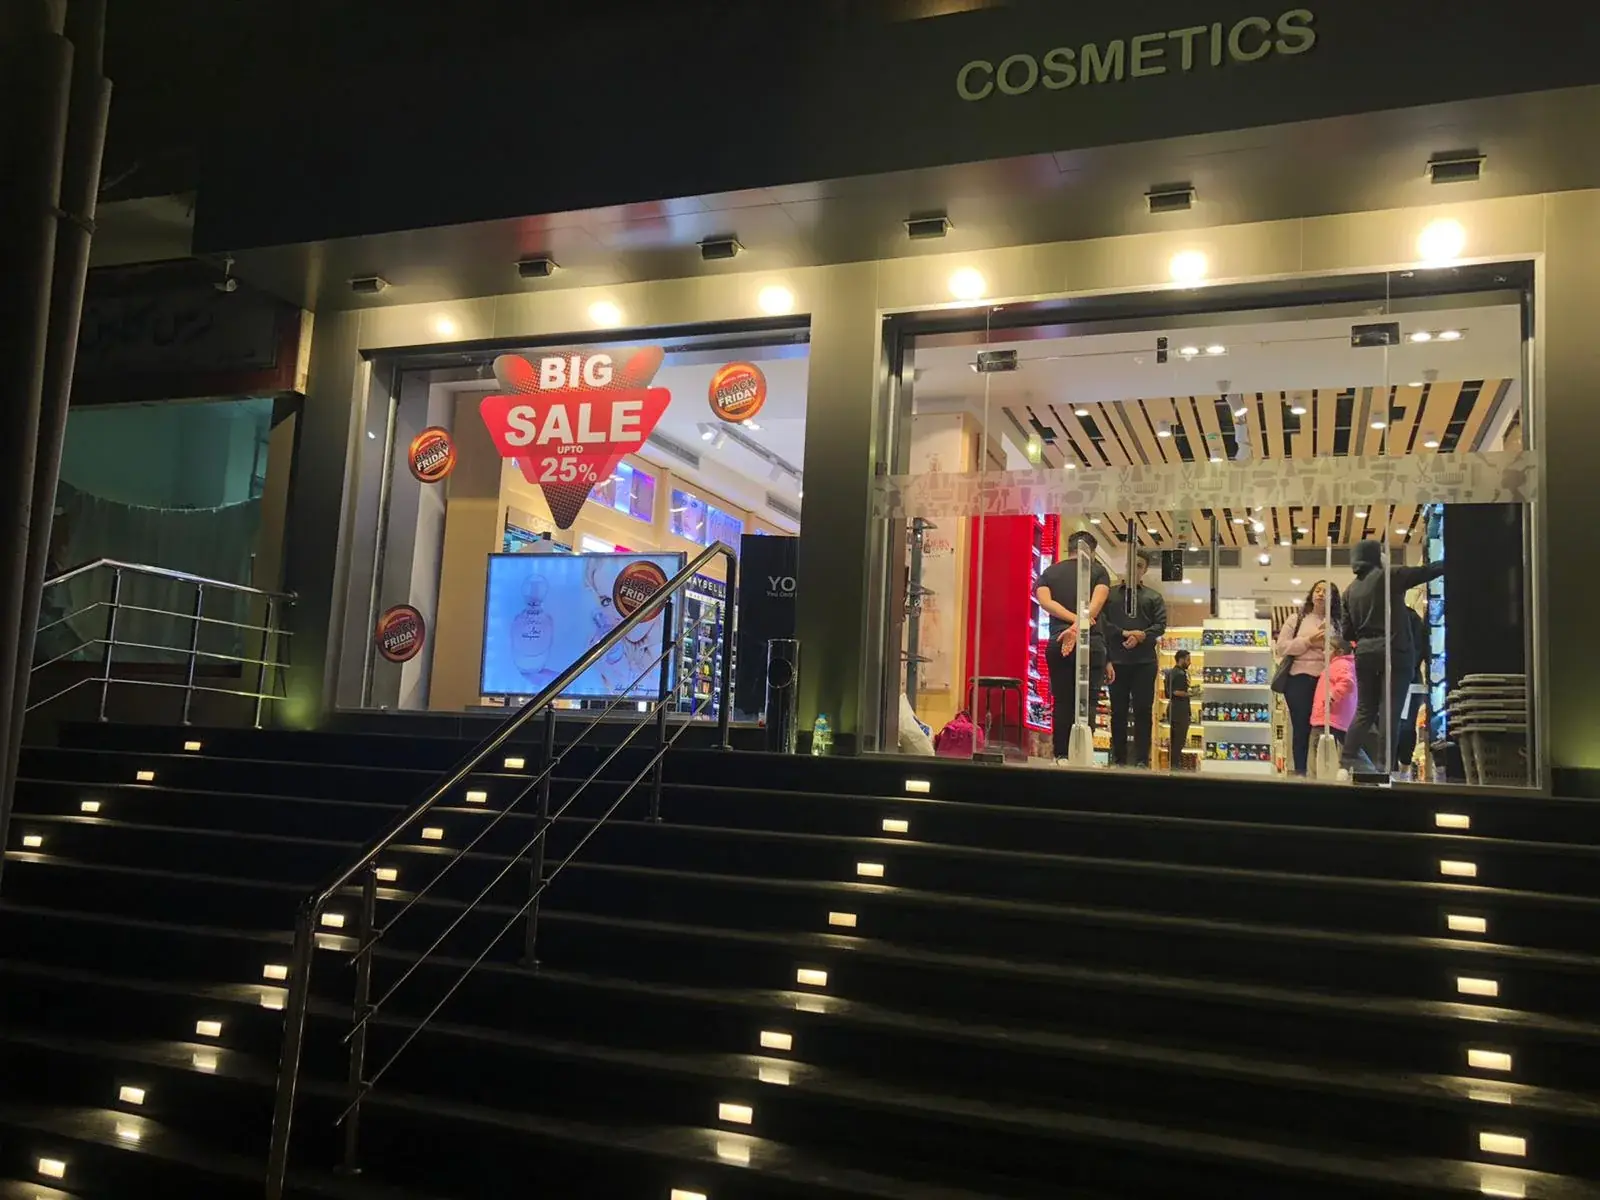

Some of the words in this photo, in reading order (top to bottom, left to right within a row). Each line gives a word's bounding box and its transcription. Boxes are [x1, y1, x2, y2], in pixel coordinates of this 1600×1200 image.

[956, 9, 1316, 101] COSMETICS
[540, 354, 613, 389] BIG
[716, 377, 756, 398] BLACK
[718, 386, 757, 407] FRIDAY
[504, 400, 643, 446] SALE
[414, 440, 448, 463] BLACK
[416, 447, 449, 471] FRIDAY
[557, 445, 584, 455] UPTO
[539, 457, 598, 482] 25%
[620, 586, 649, 602] FRID
[384, 628, 417, 648] FRIDAY
